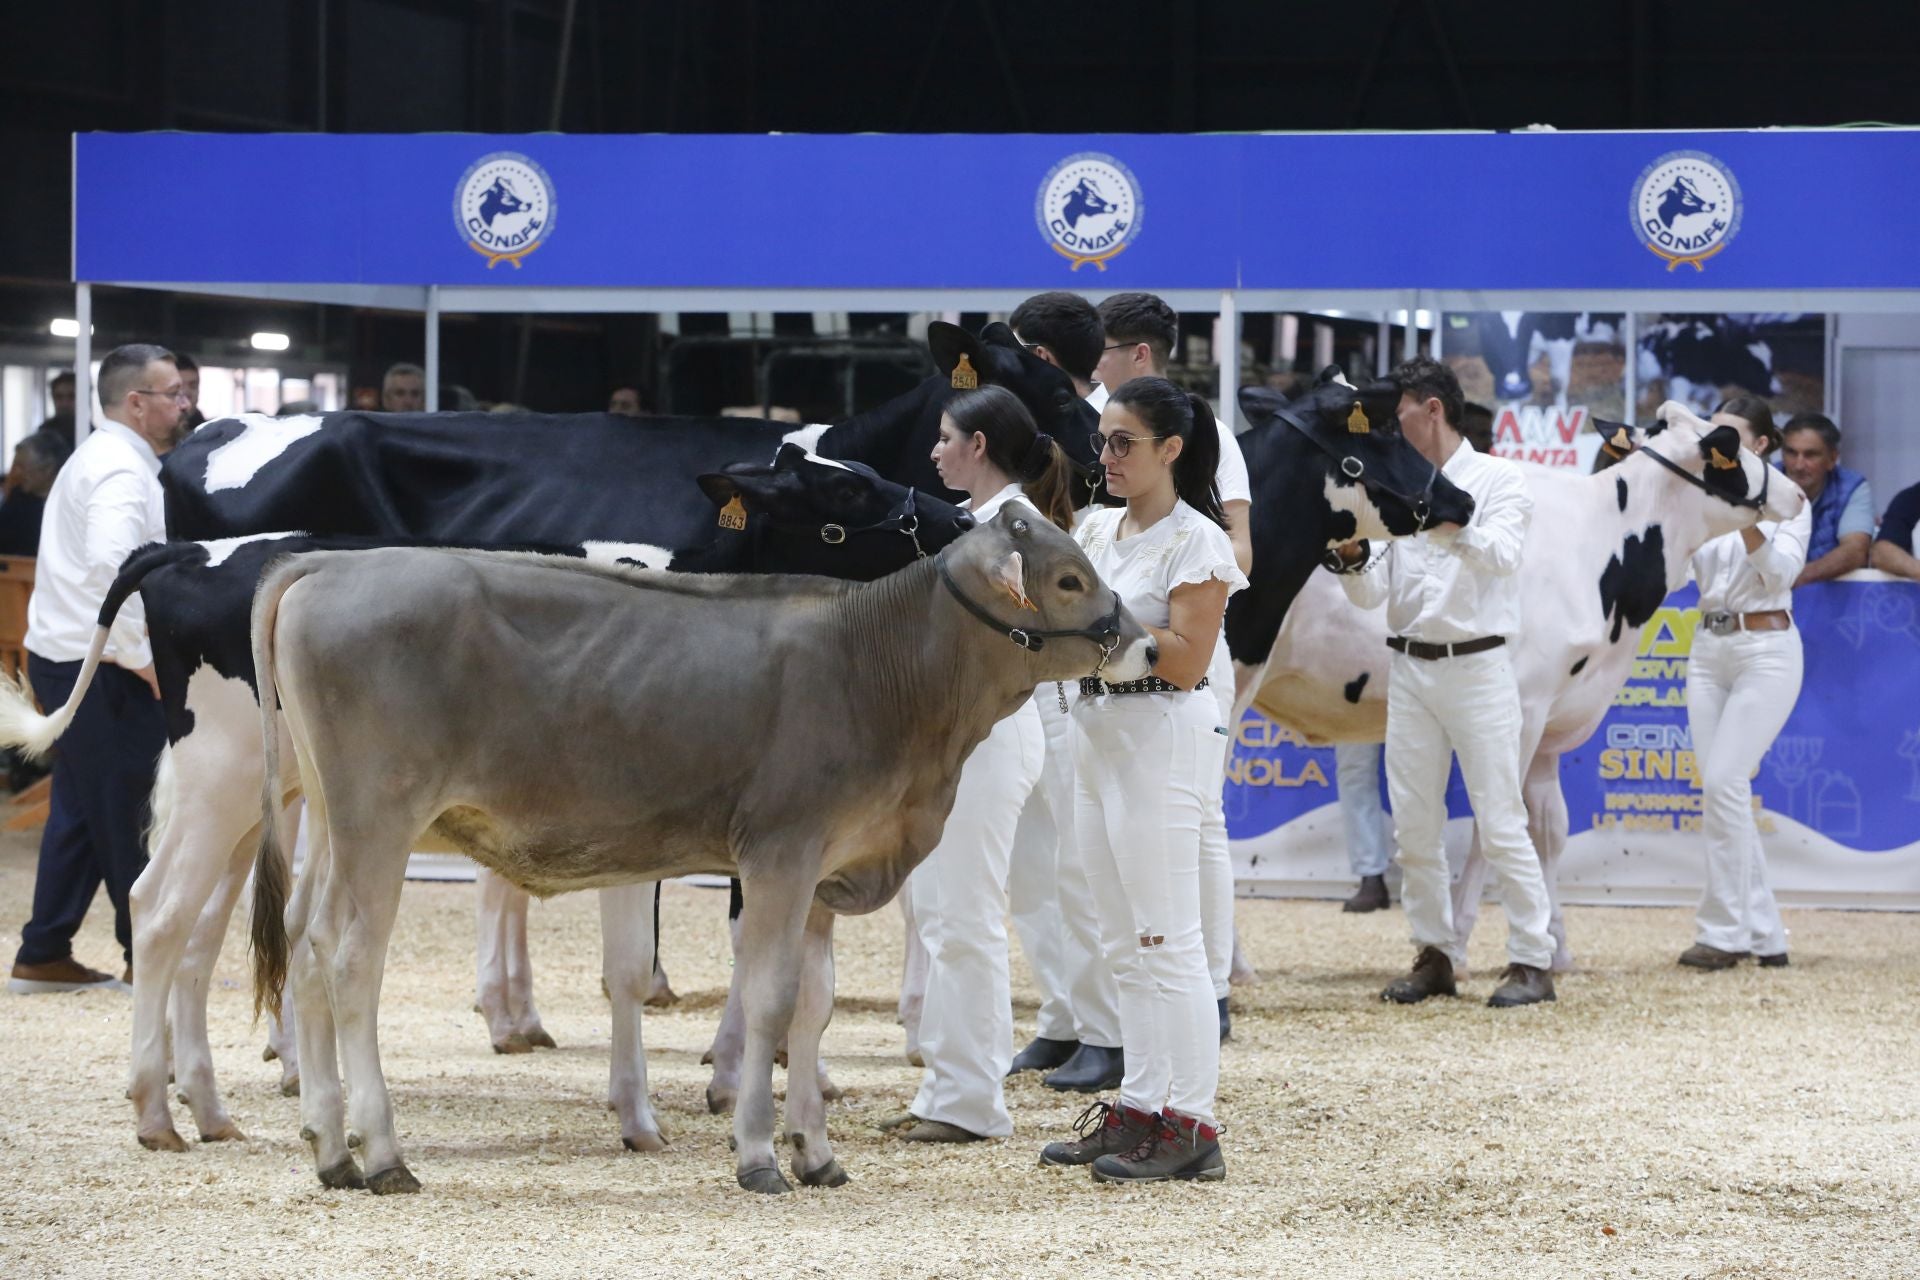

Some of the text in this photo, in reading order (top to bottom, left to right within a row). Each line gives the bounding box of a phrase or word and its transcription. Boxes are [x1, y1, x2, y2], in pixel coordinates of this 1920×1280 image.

[467, 217, 542, 248] CONAFE
[1050, 219, 1129, 251] CONAFE
[1645, 217, 1727, 251] CONAFE
[719, 513, 745, 529] 8843
